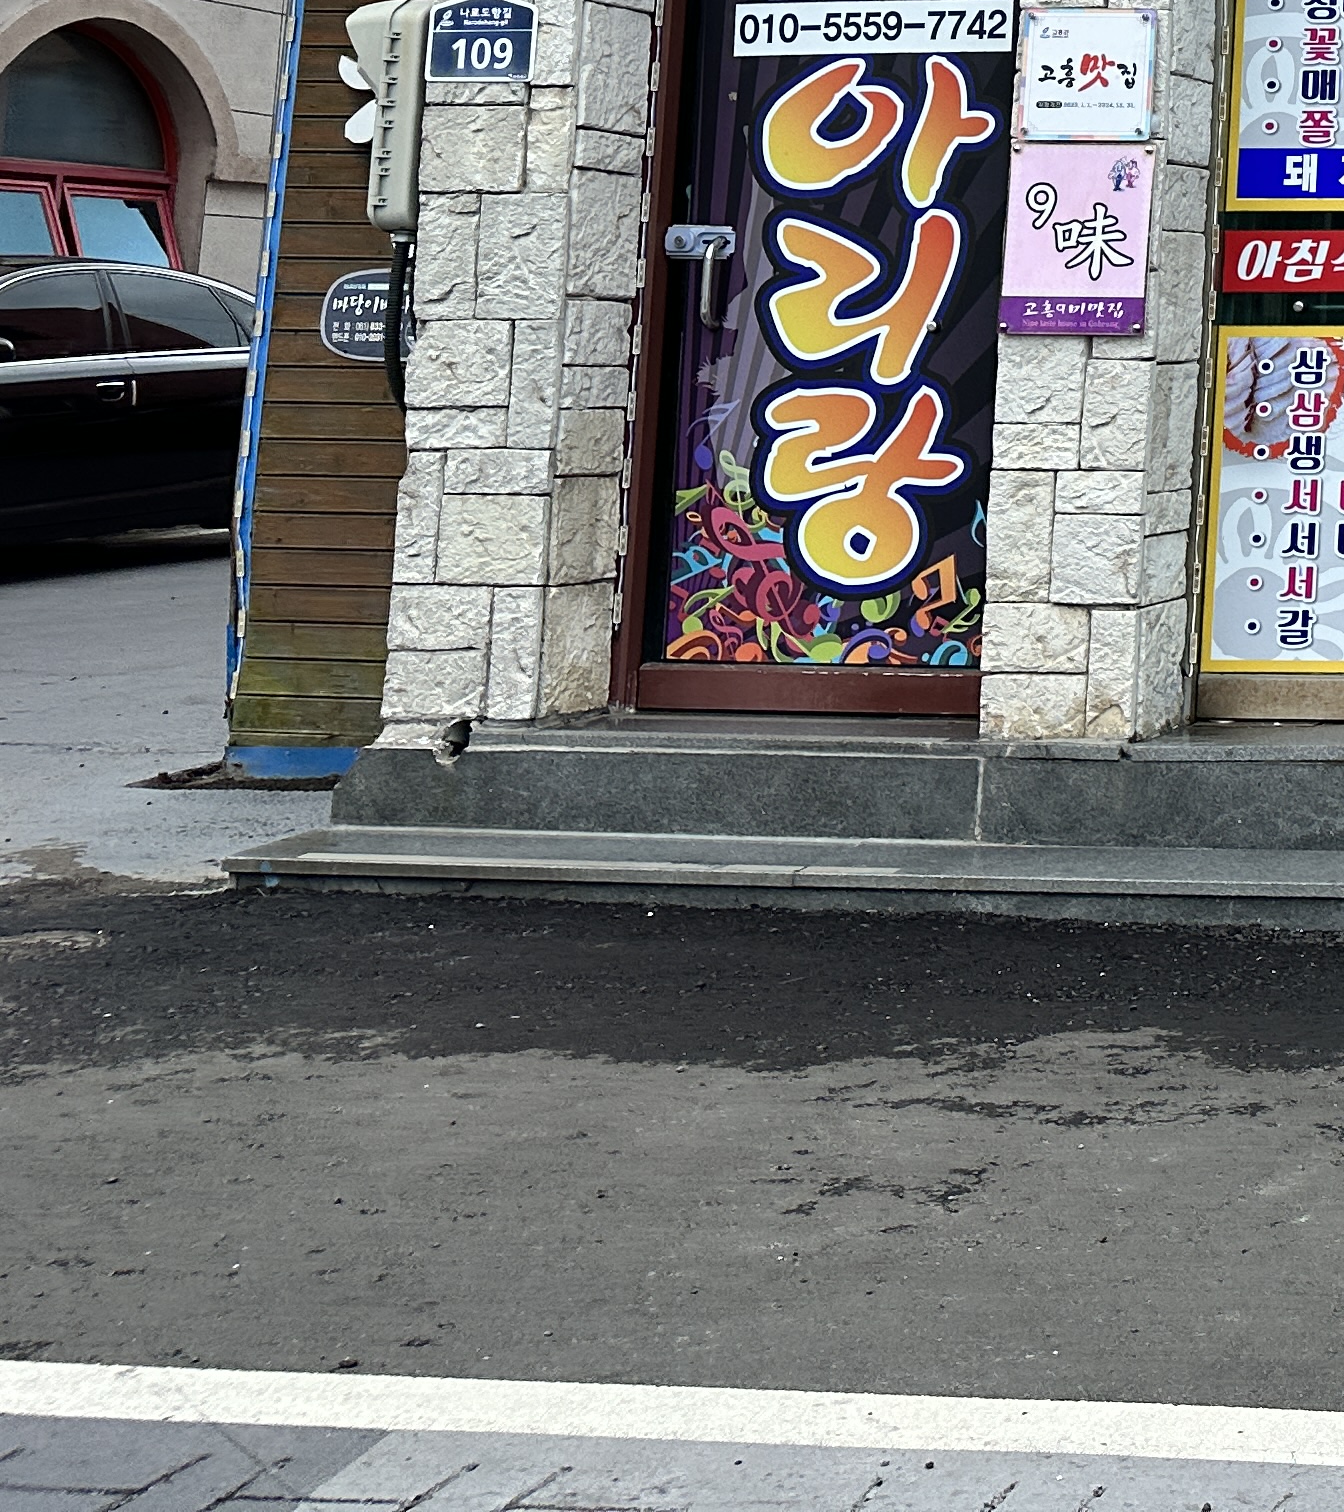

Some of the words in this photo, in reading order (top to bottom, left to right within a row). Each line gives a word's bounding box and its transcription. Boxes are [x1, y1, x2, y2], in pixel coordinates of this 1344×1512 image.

[738, 9, 1008, 45] 010-5559-7742
[451, 37, 514, 70] 109
[762, 55, 996, 586] 아리랑
